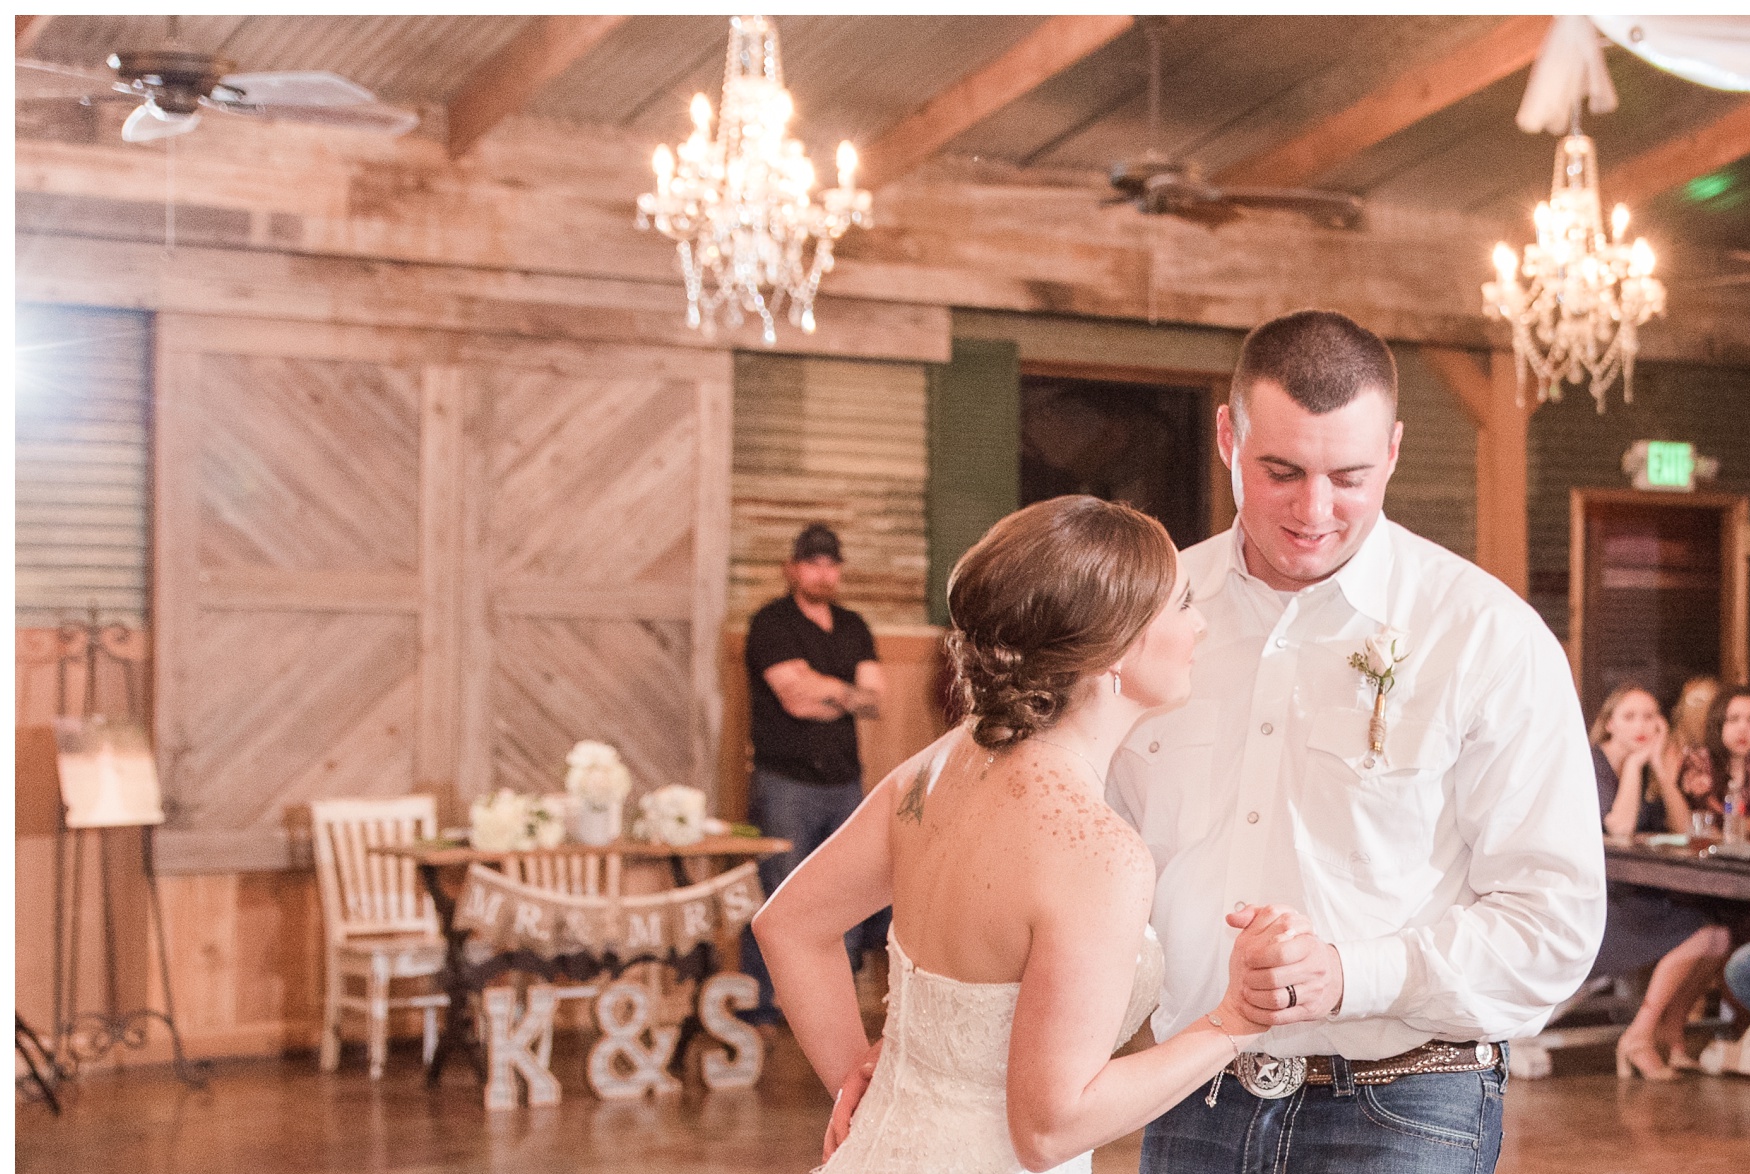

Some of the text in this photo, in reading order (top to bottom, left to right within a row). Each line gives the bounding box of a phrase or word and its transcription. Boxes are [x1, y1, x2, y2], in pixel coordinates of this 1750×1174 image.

[483, 973, 764, 1110] K & S
